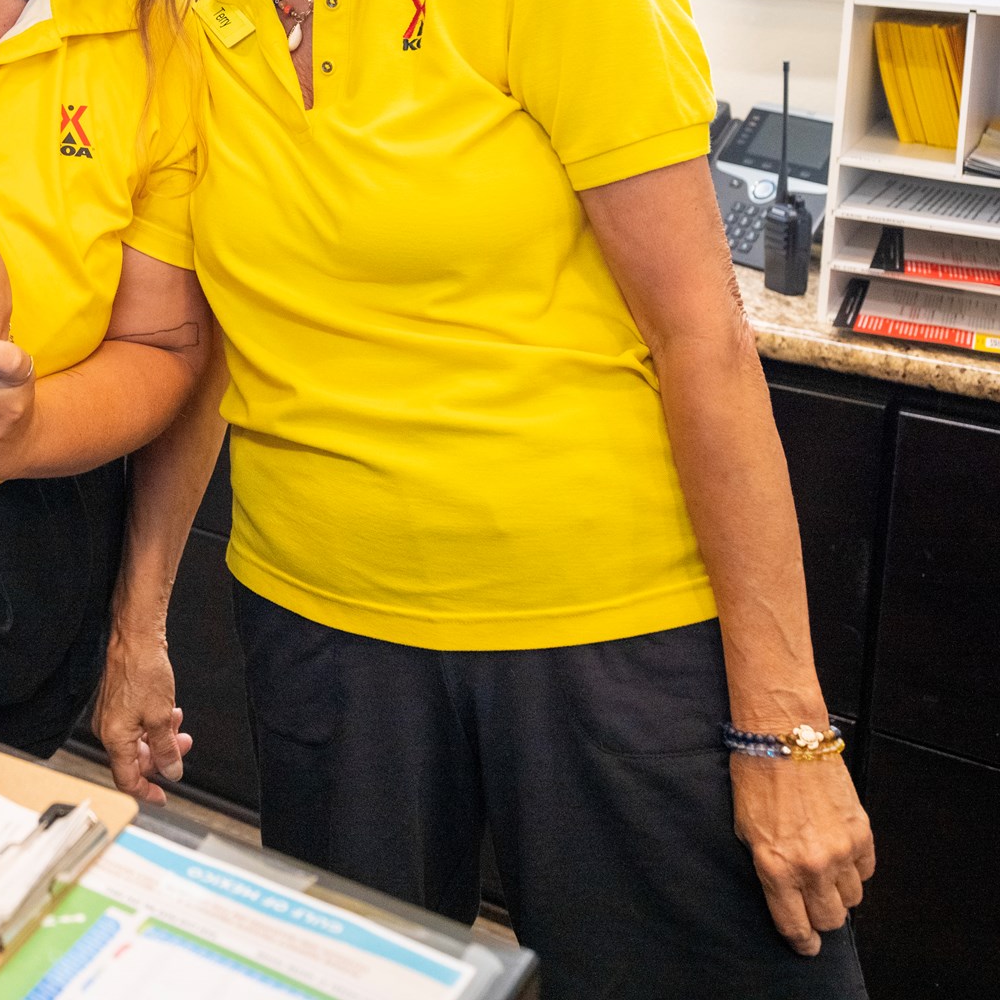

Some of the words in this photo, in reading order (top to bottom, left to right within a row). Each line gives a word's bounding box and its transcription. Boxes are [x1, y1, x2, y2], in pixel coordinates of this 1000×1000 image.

[60, 145, 93, 159] OA
[186, 866, 261, 901] MEXICO
[262, 896, 289, 913] OF
[290, 909, 344, 934] GULF
